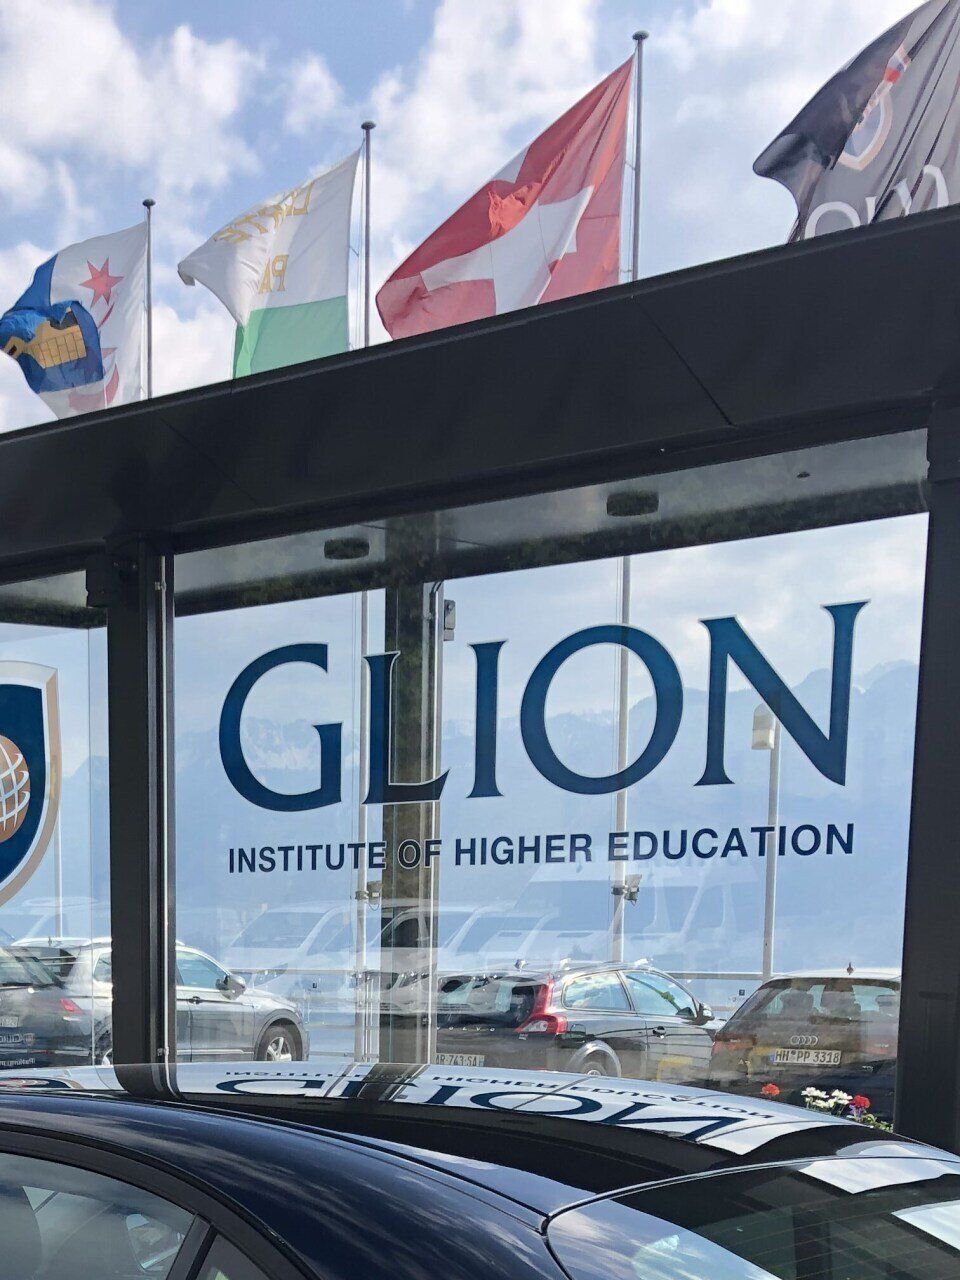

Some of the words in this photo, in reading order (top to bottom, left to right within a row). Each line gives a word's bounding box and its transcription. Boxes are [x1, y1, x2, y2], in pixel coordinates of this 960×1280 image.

[219, 599, 872, 813] GLION
[228, 841, 388, 874] INSTITUTE
[397, 838, 443, 870] OF
[454, 833, 593, 867] HIGHER
[607, 822, 855, 862] EDUCATION
[796, 1050, 811, 1063] PP
[812, 1050, 841, 1064] 3318
